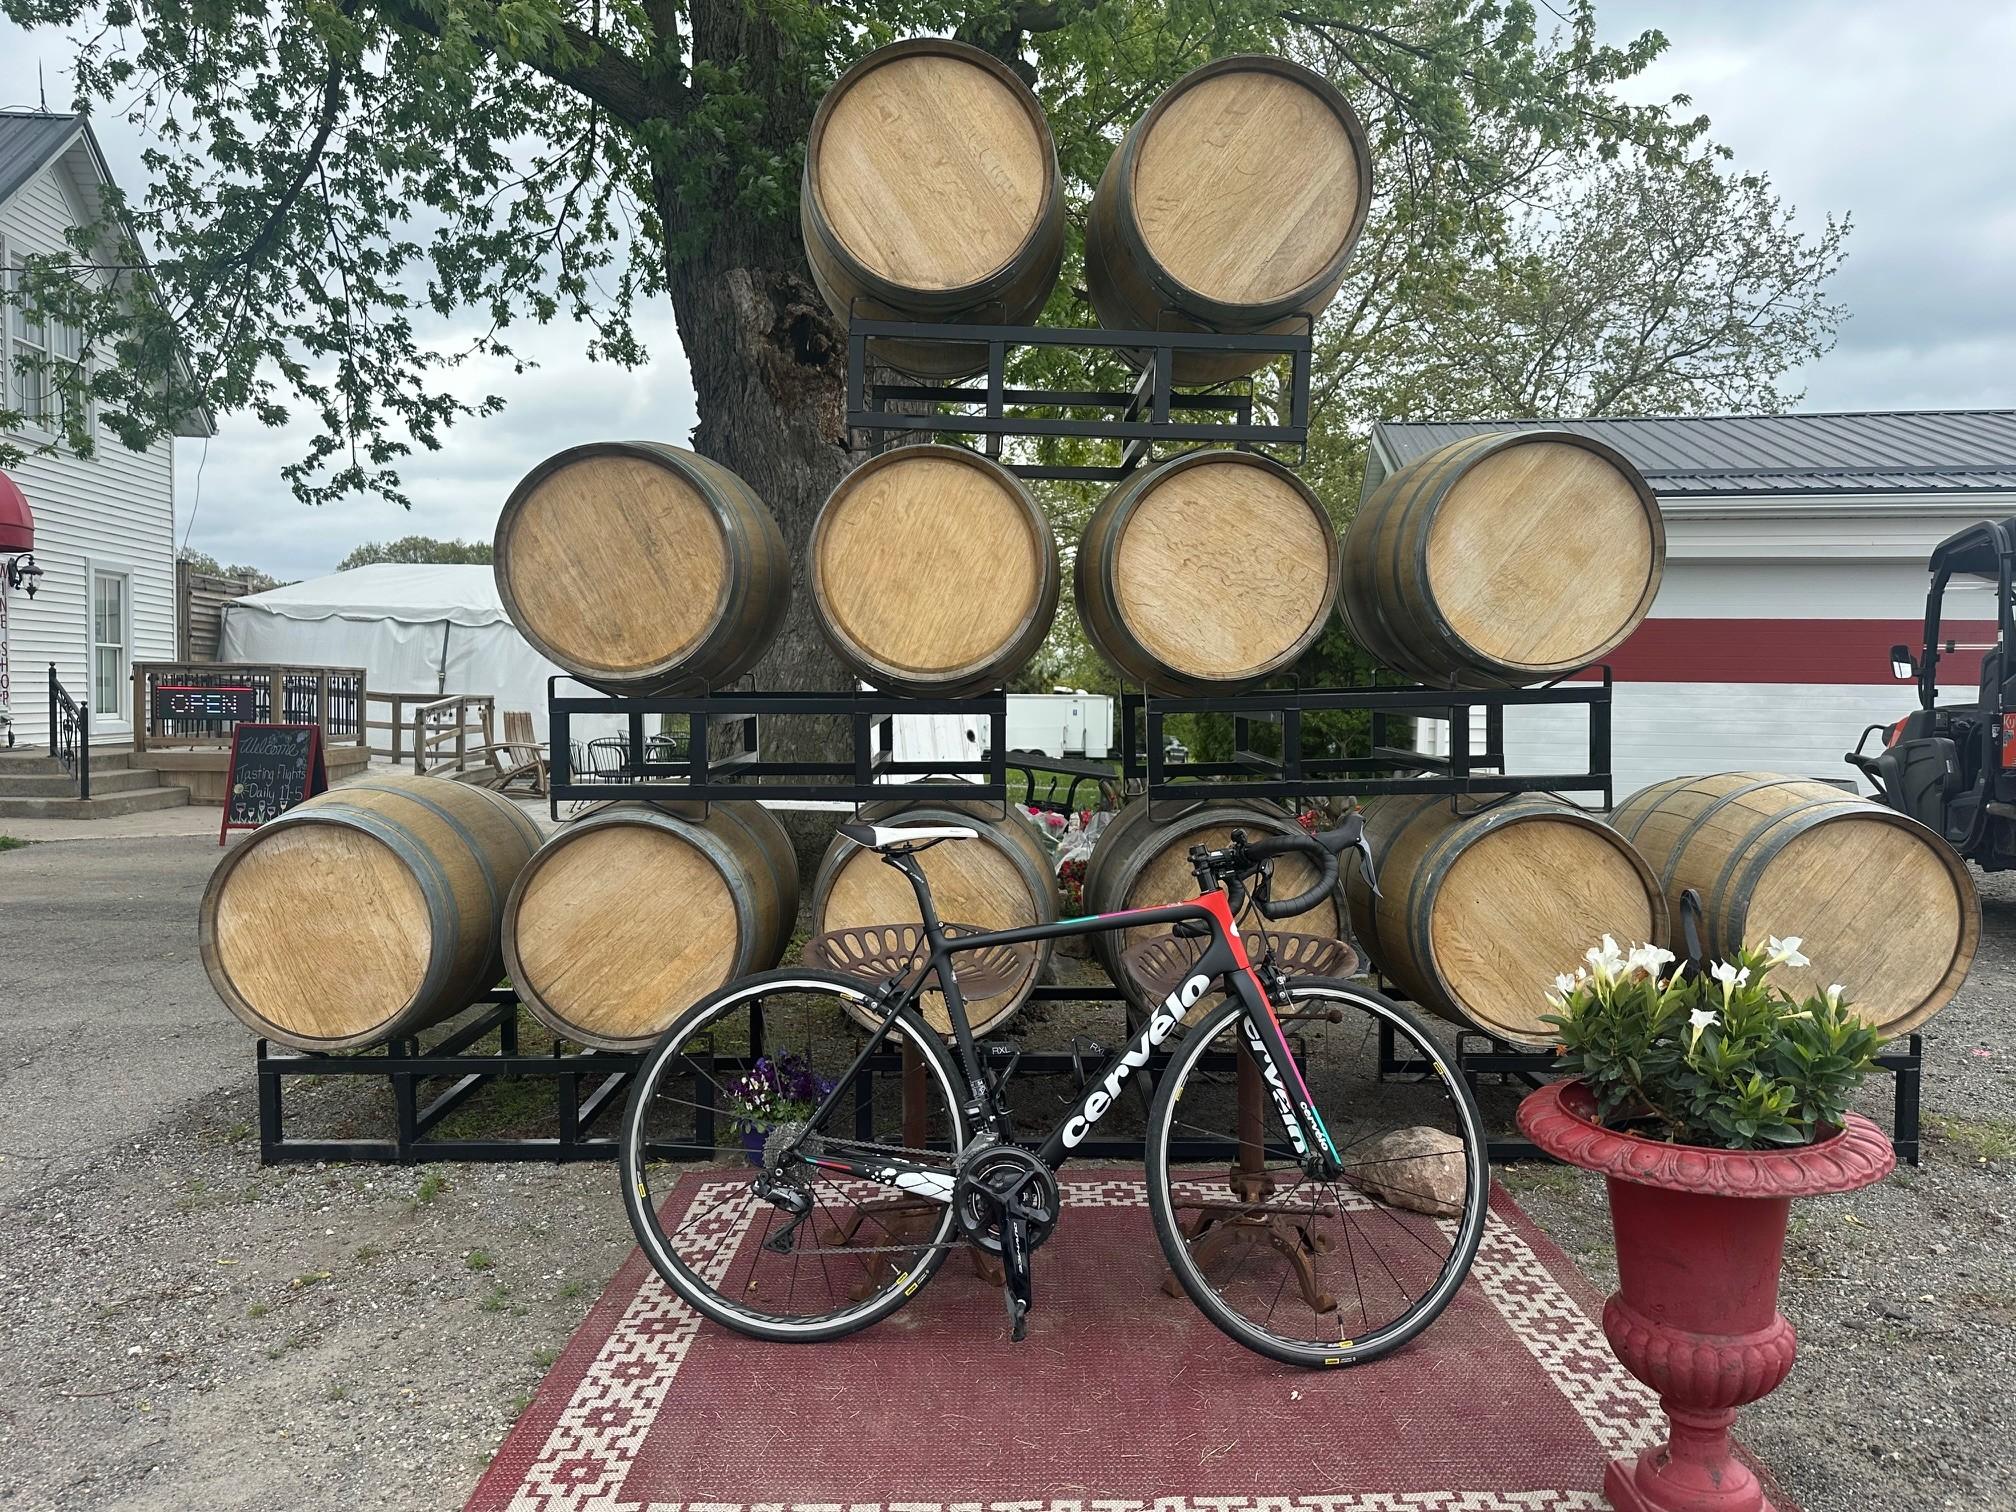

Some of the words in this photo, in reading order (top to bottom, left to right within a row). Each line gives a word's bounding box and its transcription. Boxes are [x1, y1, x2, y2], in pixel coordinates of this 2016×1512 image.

[1, 641, 9, 705] SHOP
[170, 694, 237, 713] OPEN
[240, 736, 299, 757] Welcome
[237, 763, 275, 787] Tasting
[277, 764, 306, 787] Flights
[249, 783, 275, 805] Daily
[280, 785, 303, 801] 11-5
[992, 1046, 1011, 1055] RXL
